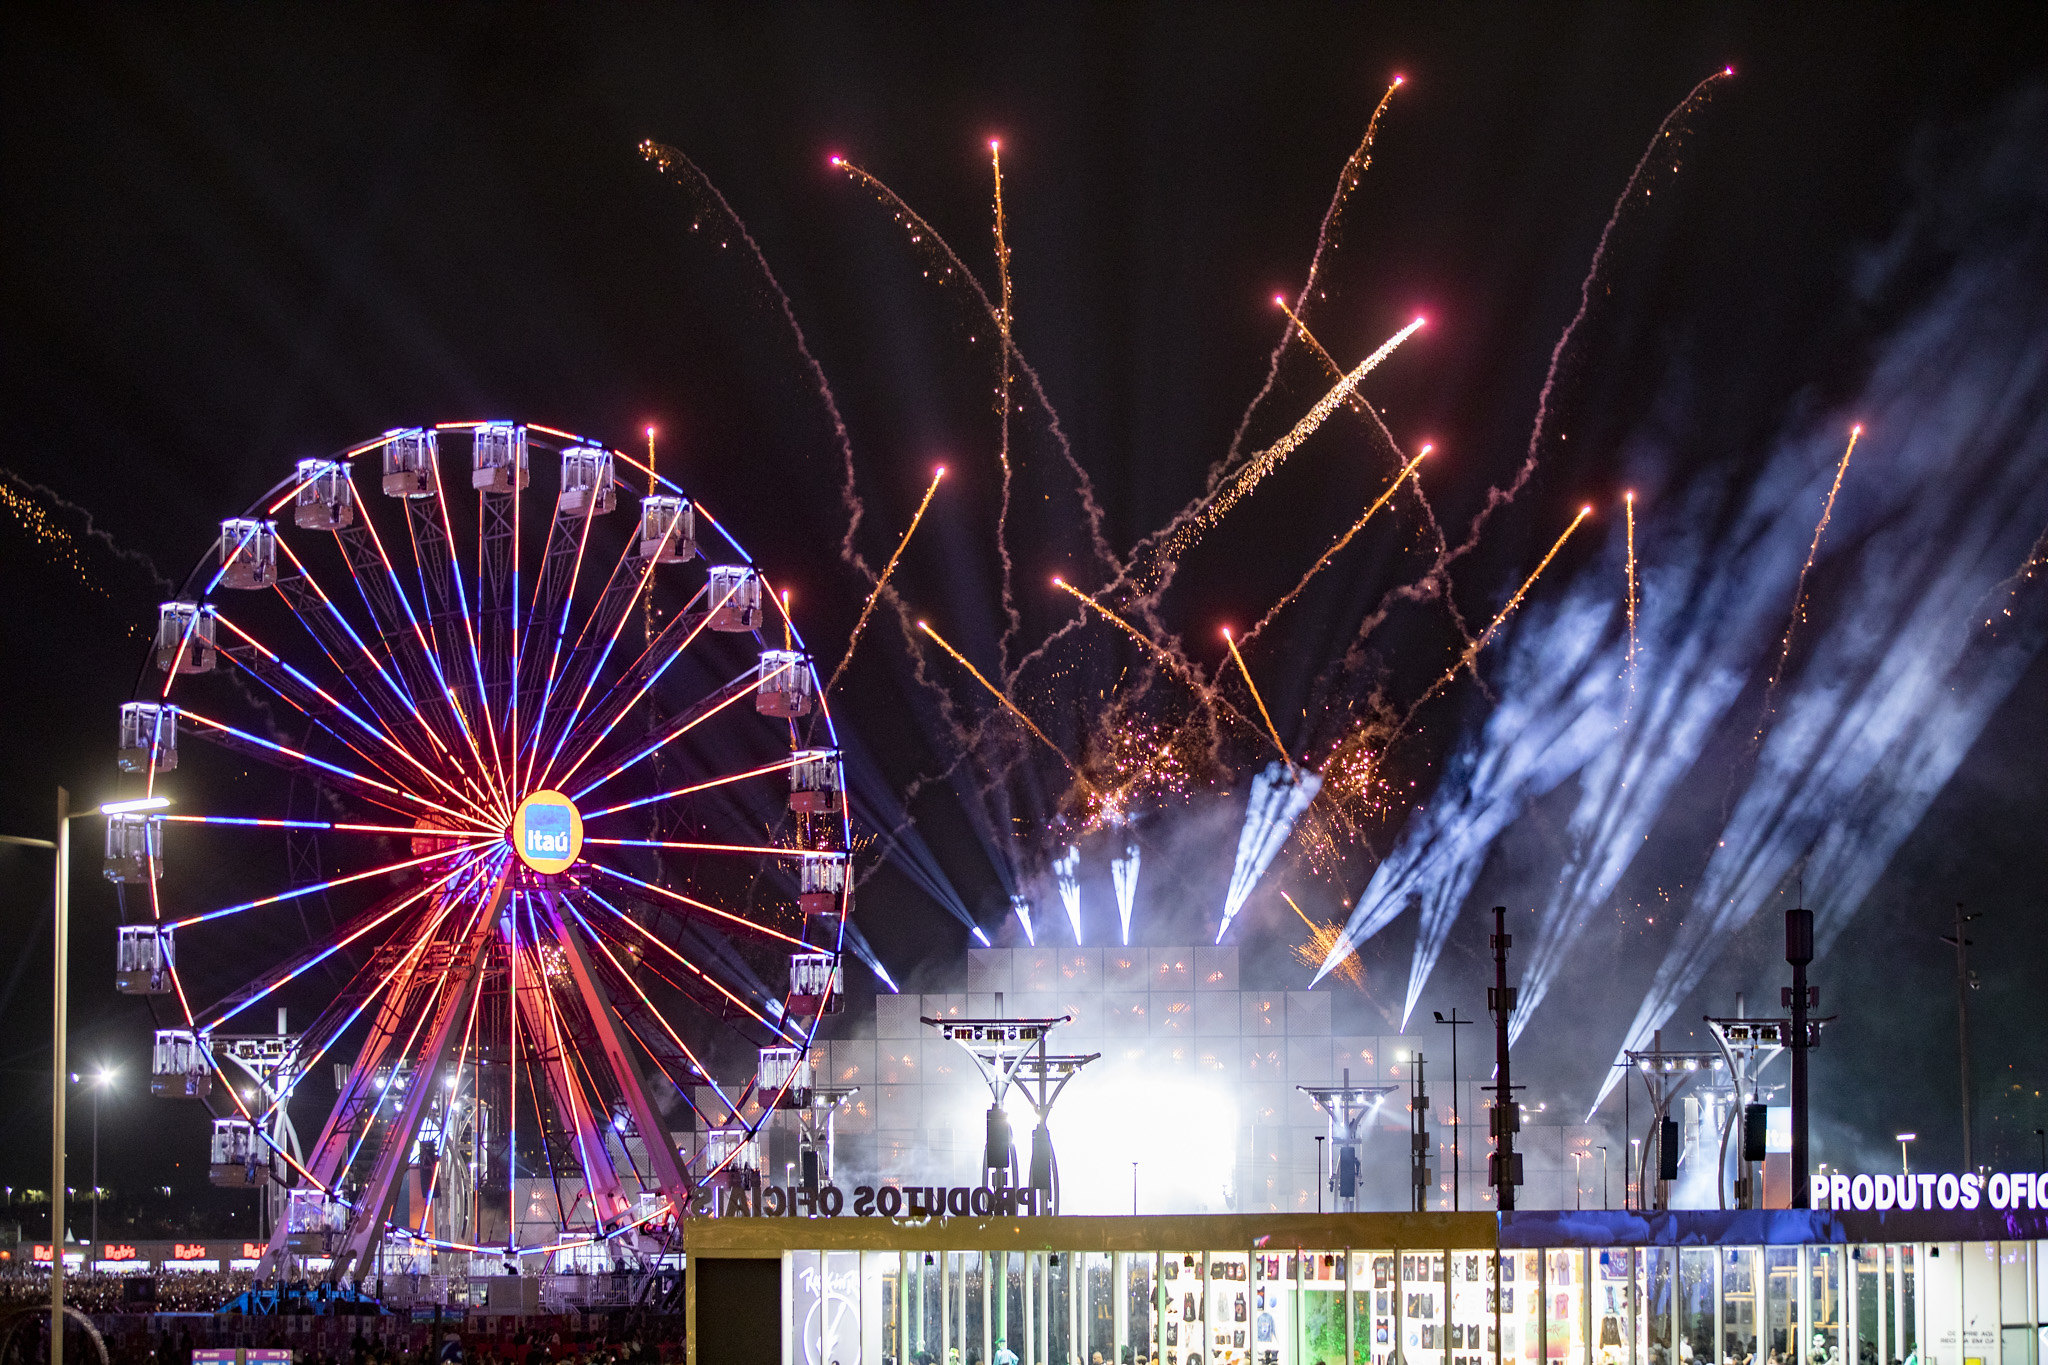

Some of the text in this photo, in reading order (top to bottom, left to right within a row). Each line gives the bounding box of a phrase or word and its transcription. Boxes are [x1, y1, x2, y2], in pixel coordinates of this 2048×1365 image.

[528, 829, 568, 852] Itaú
[1765, 1128, 1792, 1148] Ita
[1809, 1173, 1981, 1211] PRODUTOS
[104, 1244, 136, 1261] Bob's
[174, 1243, 206, 1260] Bob's
